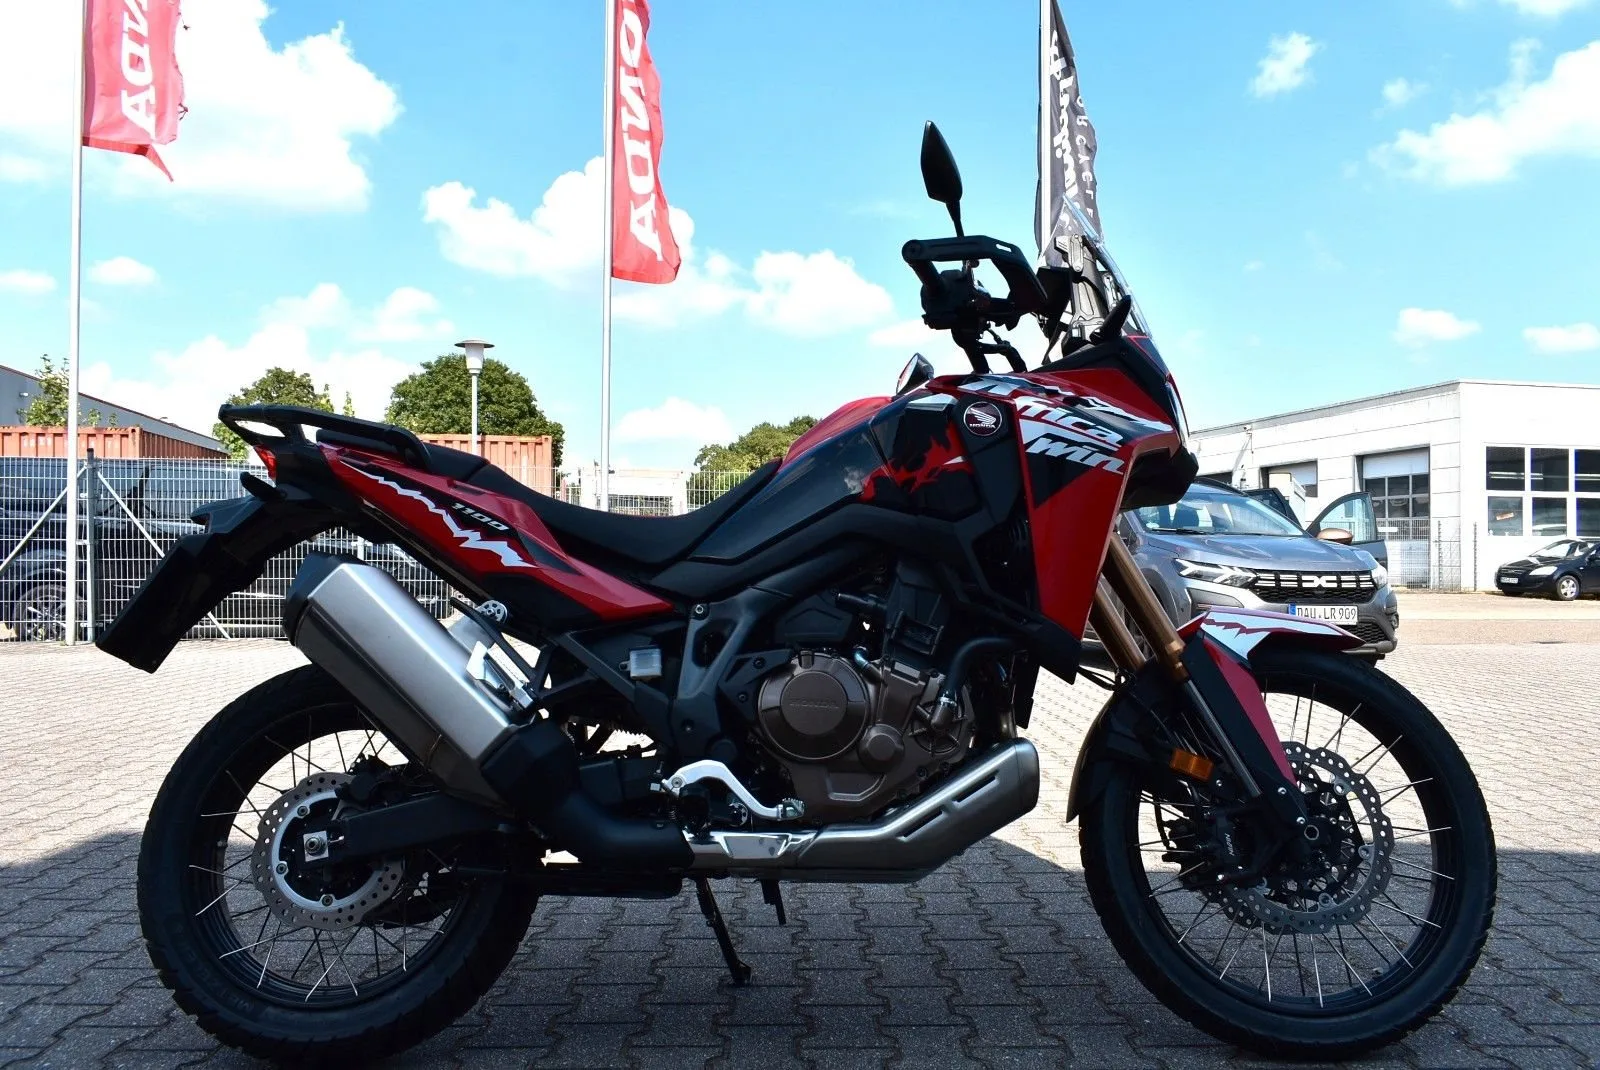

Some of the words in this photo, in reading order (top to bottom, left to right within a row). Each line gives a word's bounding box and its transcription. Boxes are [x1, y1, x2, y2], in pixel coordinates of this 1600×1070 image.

[452, 502, 510, 531] 1100
[1324, 607, 1336, 620] LR
[1339, 607, 1356, 620] 909
